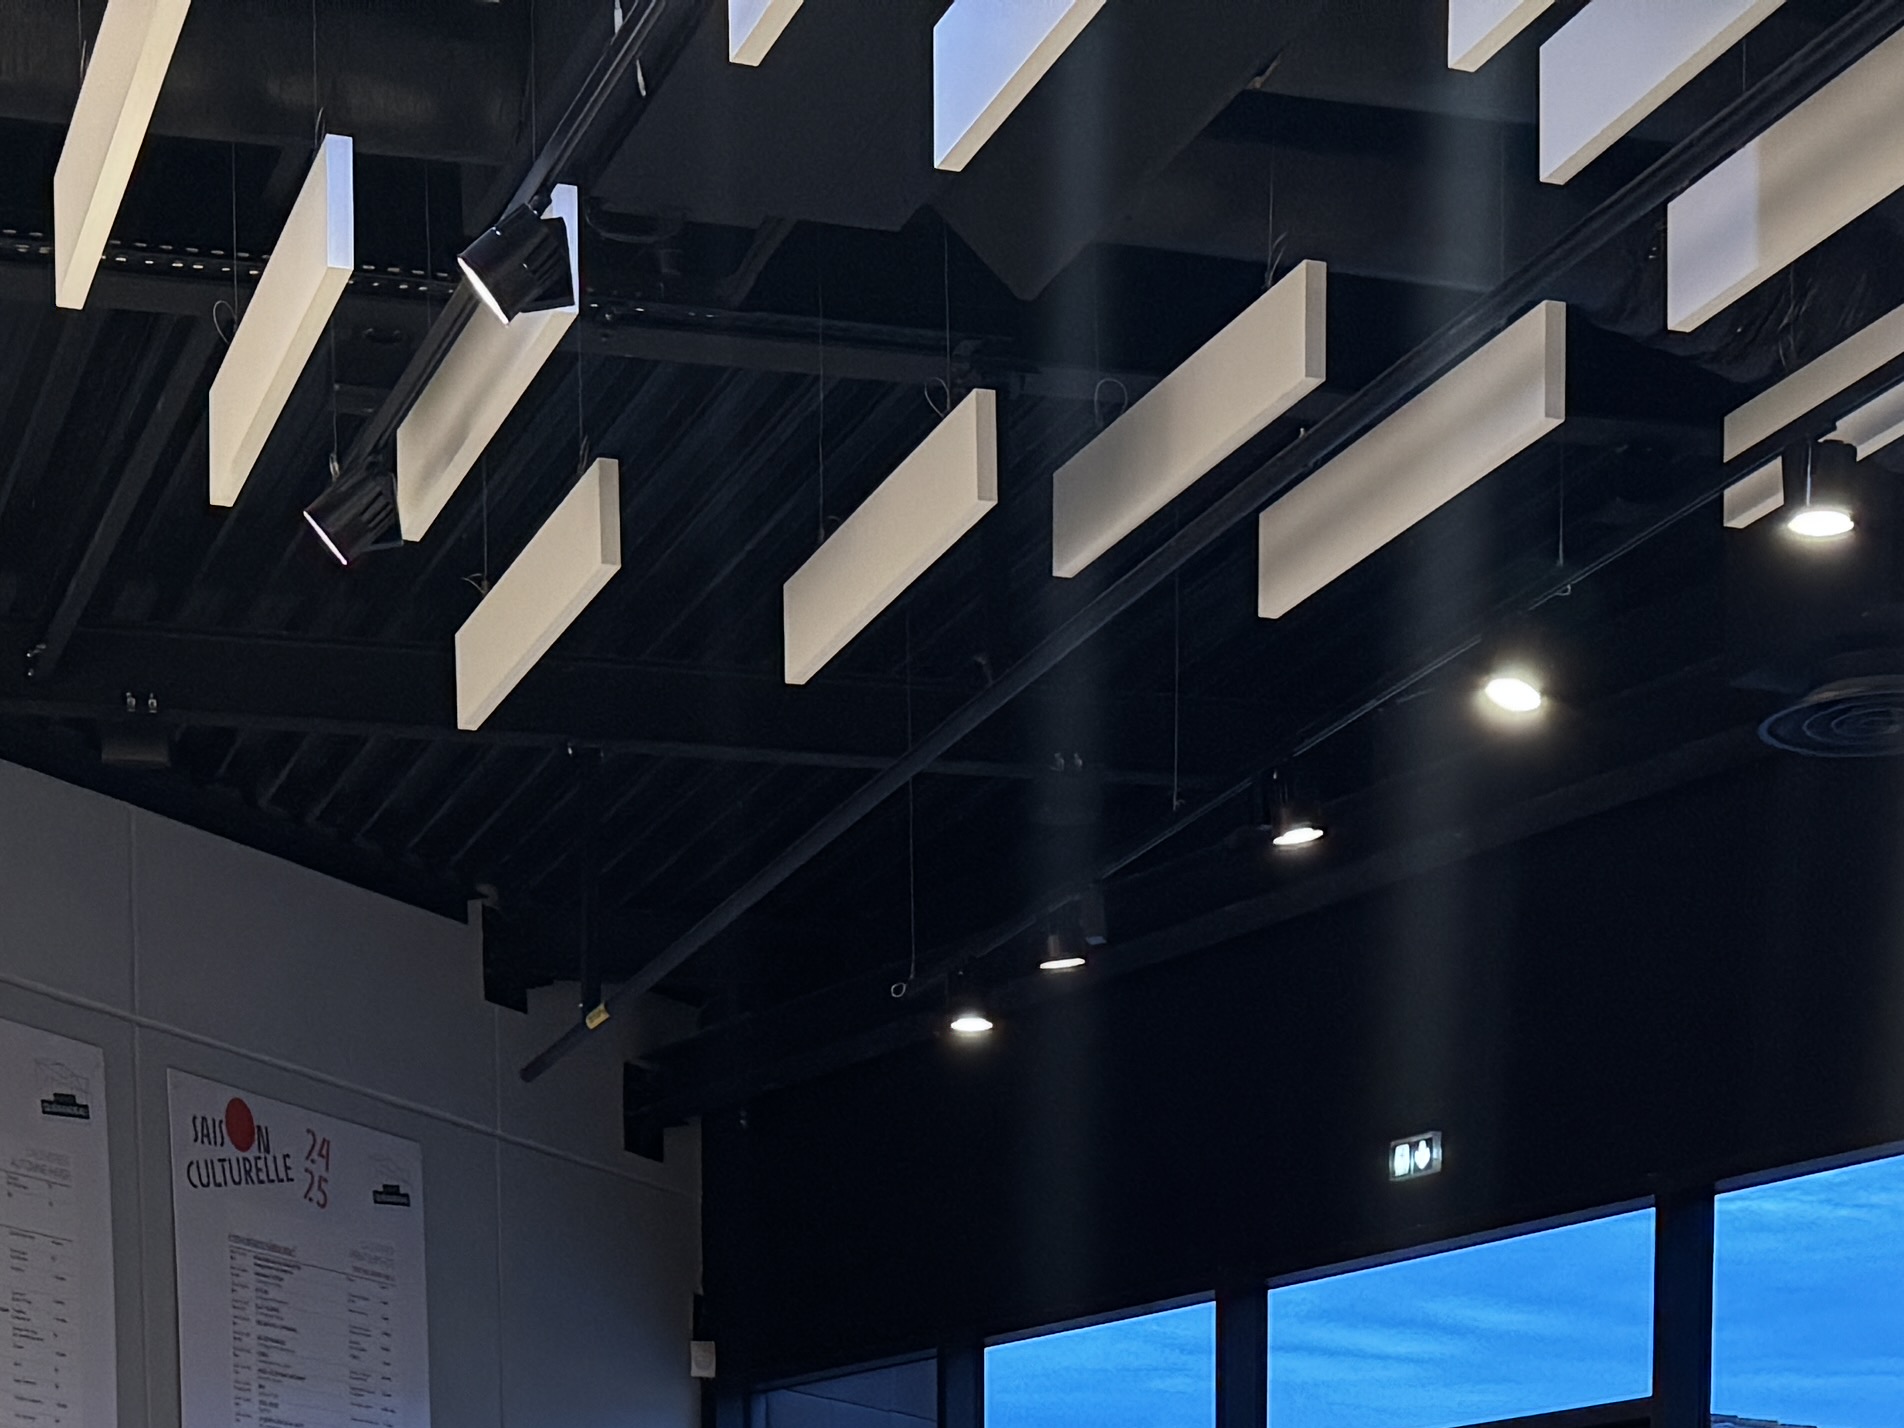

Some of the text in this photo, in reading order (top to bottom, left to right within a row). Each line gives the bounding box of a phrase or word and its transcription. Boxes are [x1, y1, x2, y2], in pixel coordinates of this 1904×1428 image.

[191, 1097, 271, 1155] SAISON
[186, 1153, 295, 1189] CULTURELLE
[305, 1128, 331, 1173] 24
[303, 1167, 329, 1209] 25
